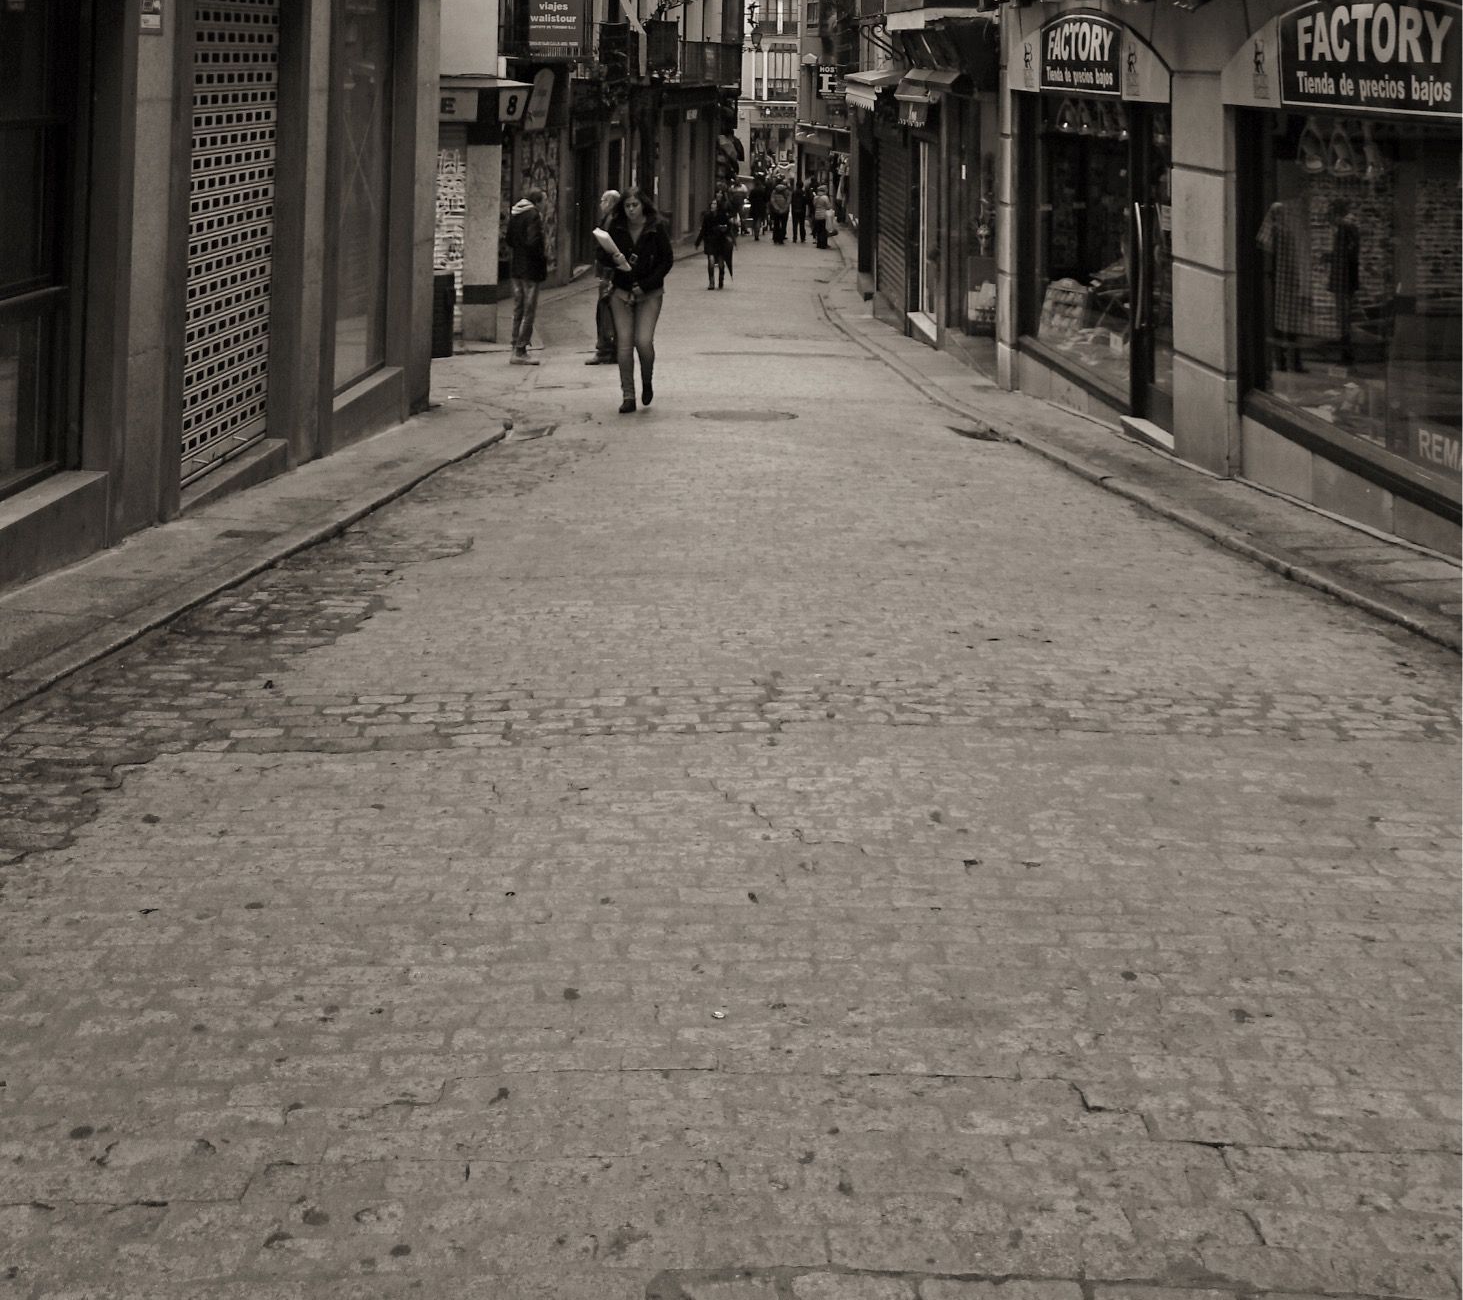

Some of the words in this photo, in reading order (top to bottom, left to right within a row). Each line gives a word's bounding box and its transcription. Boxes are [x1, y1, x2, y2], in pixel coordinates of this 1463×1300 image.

[530, 13, 577, 23] walistour
[539, 1, 569, 12] viajes
[1047, 21, 1113, 62] FACTORY
[1295, 2, 1453, 64] FACTORY
[1046, 65, 1064, 82] Tienda
[1064, 67, 1072, 83] de
[1072, 67, 1094, 86] precios
[1095, 67, 1113, 88] bajos
[1296, 70, 1336, 95] Tienda
[1339, 72, 1354, 97] de
[1359, 73, 1405, 102] precios
[1411, 74, 1452, 106] bajos
[1418, 427, 1462, 472] REM
